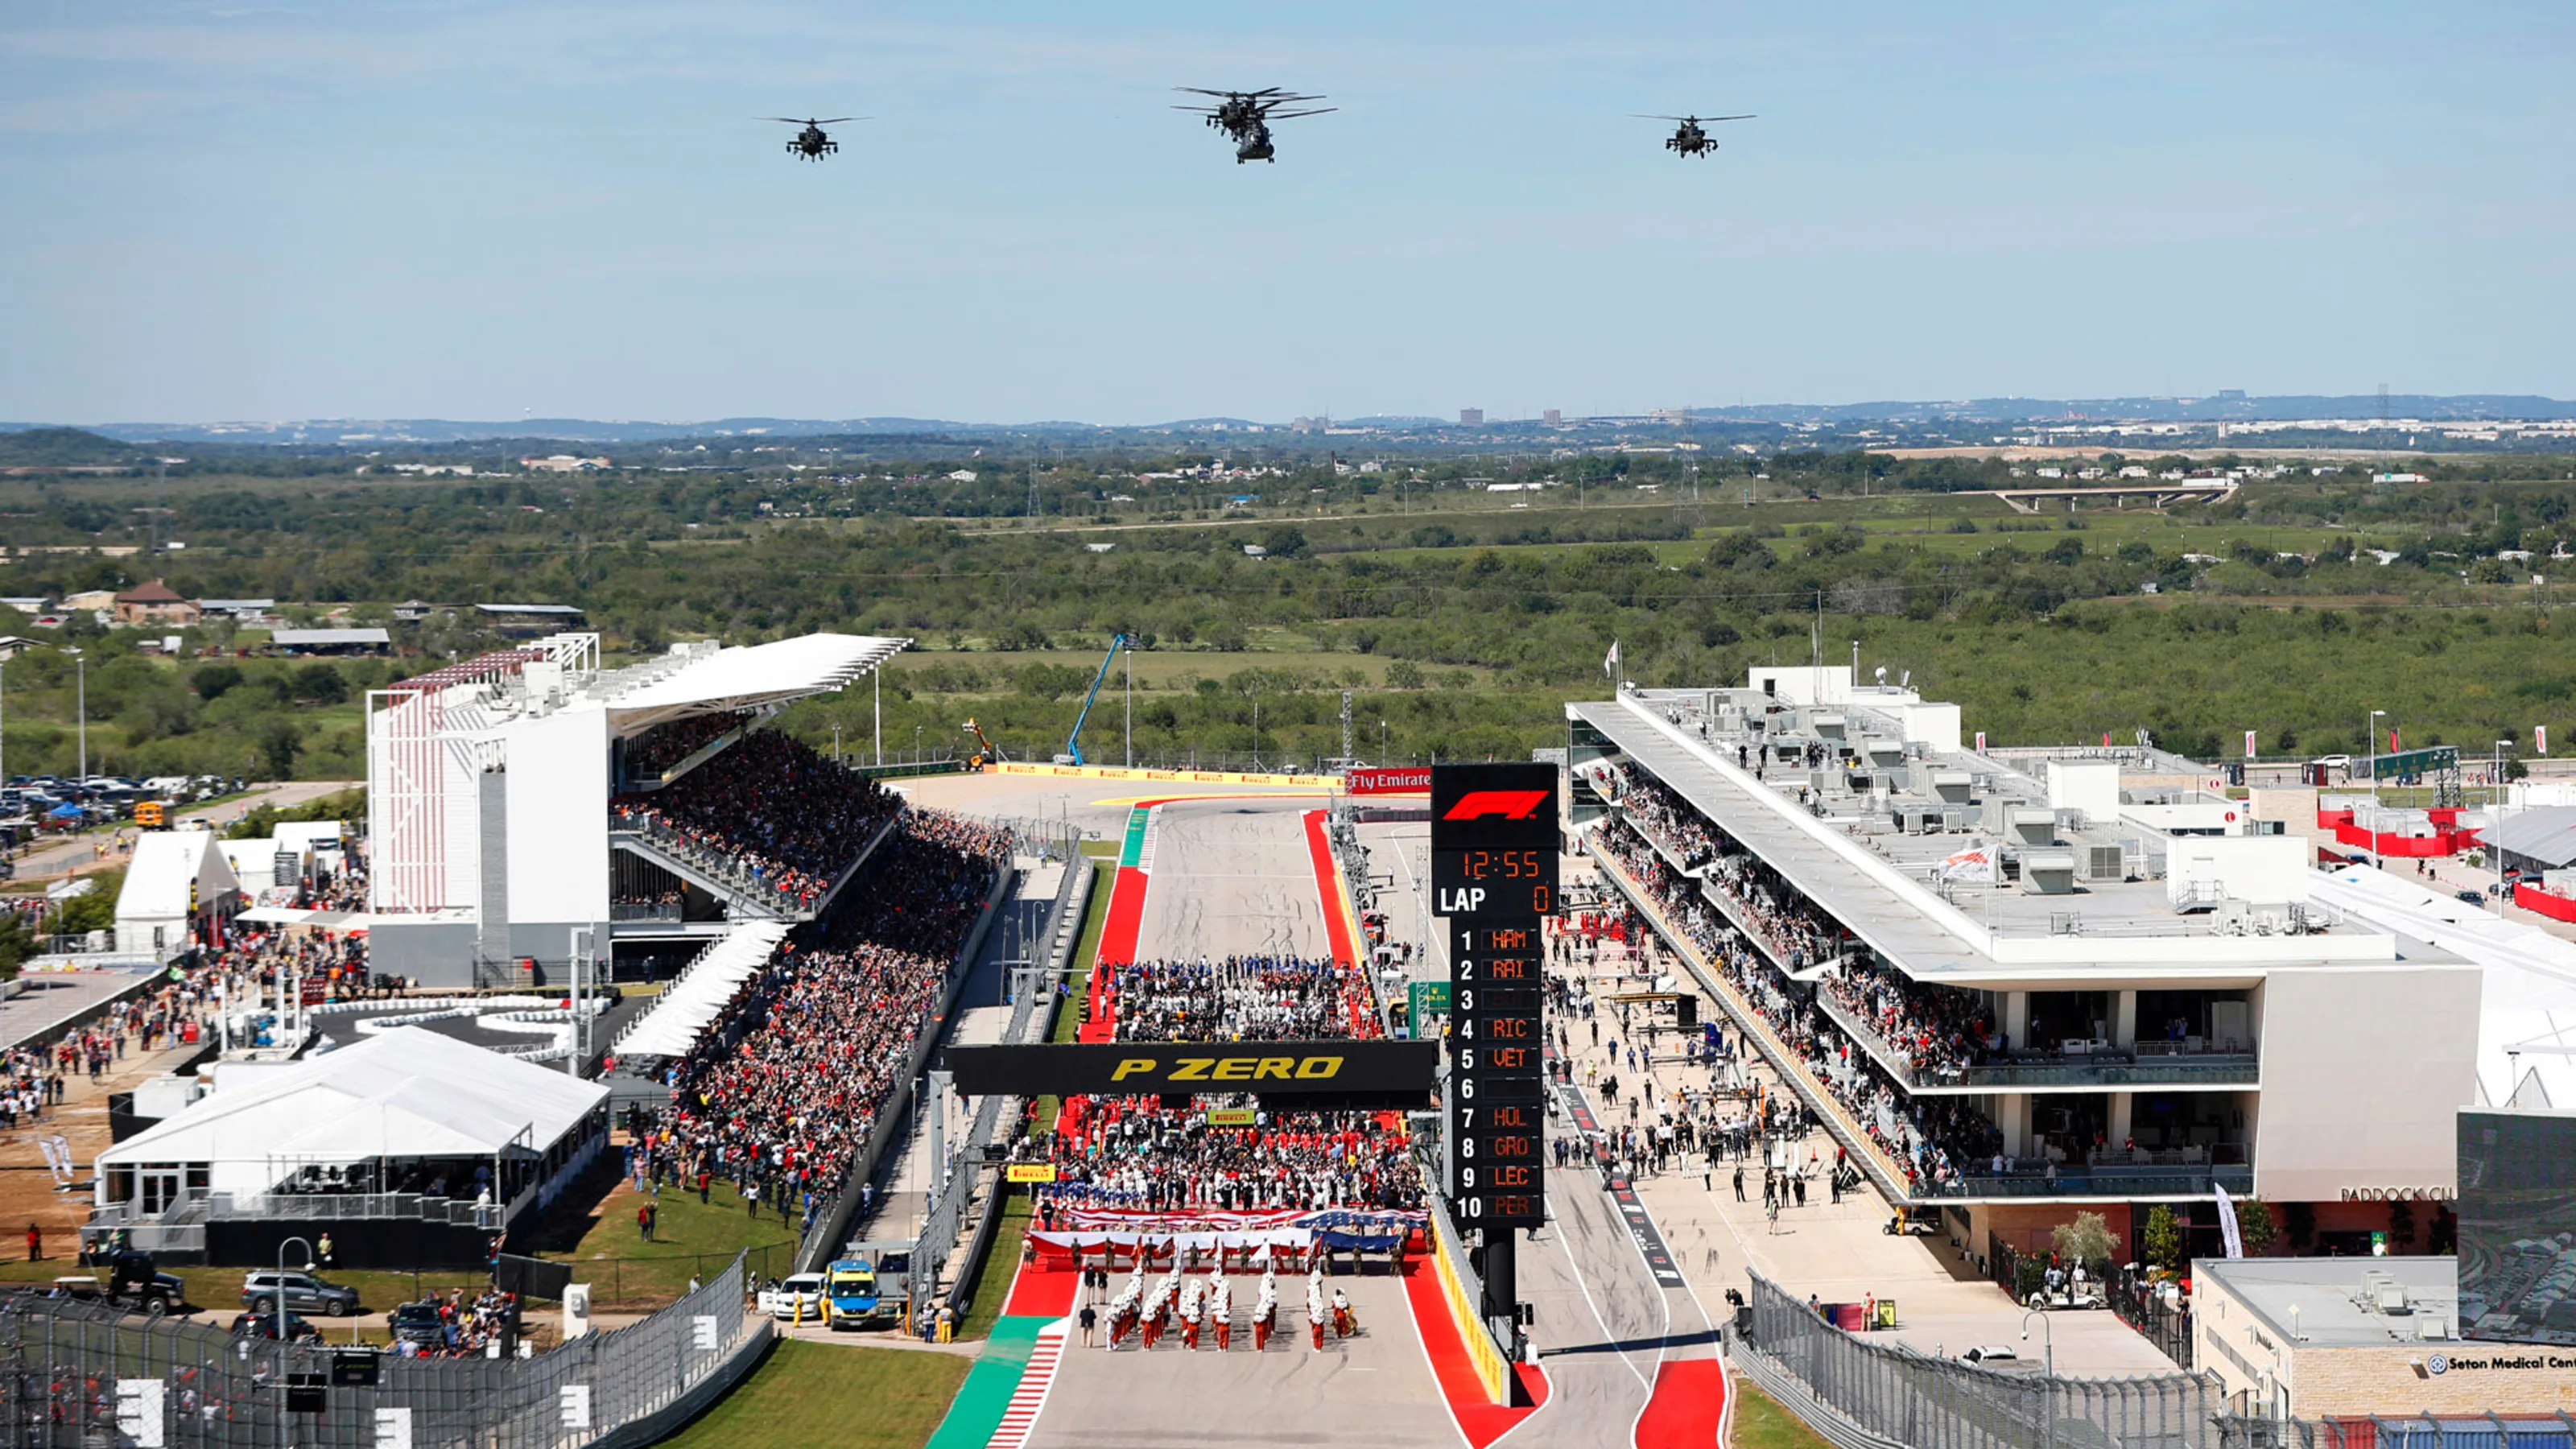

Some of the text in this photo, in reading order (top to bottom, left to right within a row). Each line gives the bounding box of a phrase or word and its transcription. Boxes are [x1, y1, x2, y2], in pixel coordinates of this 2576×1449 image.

[1352, 774, 1375, 790] Fly
[1464, 851, 1539, 878] 12:55
[1440, 886, 1549, 912] LAP 0
[1461, 931, 1526, 951] 1 HAM
[1460, 960, 1524, 980] 2 RAI
[1460, 989, 1473, 1010] 3
[1461, 1018, 1527, 1039] 4 RIC
[1111, 1056, 1344, 1081] P ZERO
[1461, 1048, 1525, 1069] 5 VET
[1461, 1078, 1474, 1099] 6
[1462, 1108, 1474, 1128] 7
[1462, 1137, 1529, 1158] 8 GRO
[1463, 1166, 1529, 1188] 9 LEC
[2342, 1187, 2427, 1202] PADDOCK
[1457, 1196, 1529, 1218] 10 PER
[2449, 1357, 2488, 1370] Seton
[2491, 1356, 2544, 1369] Medical
